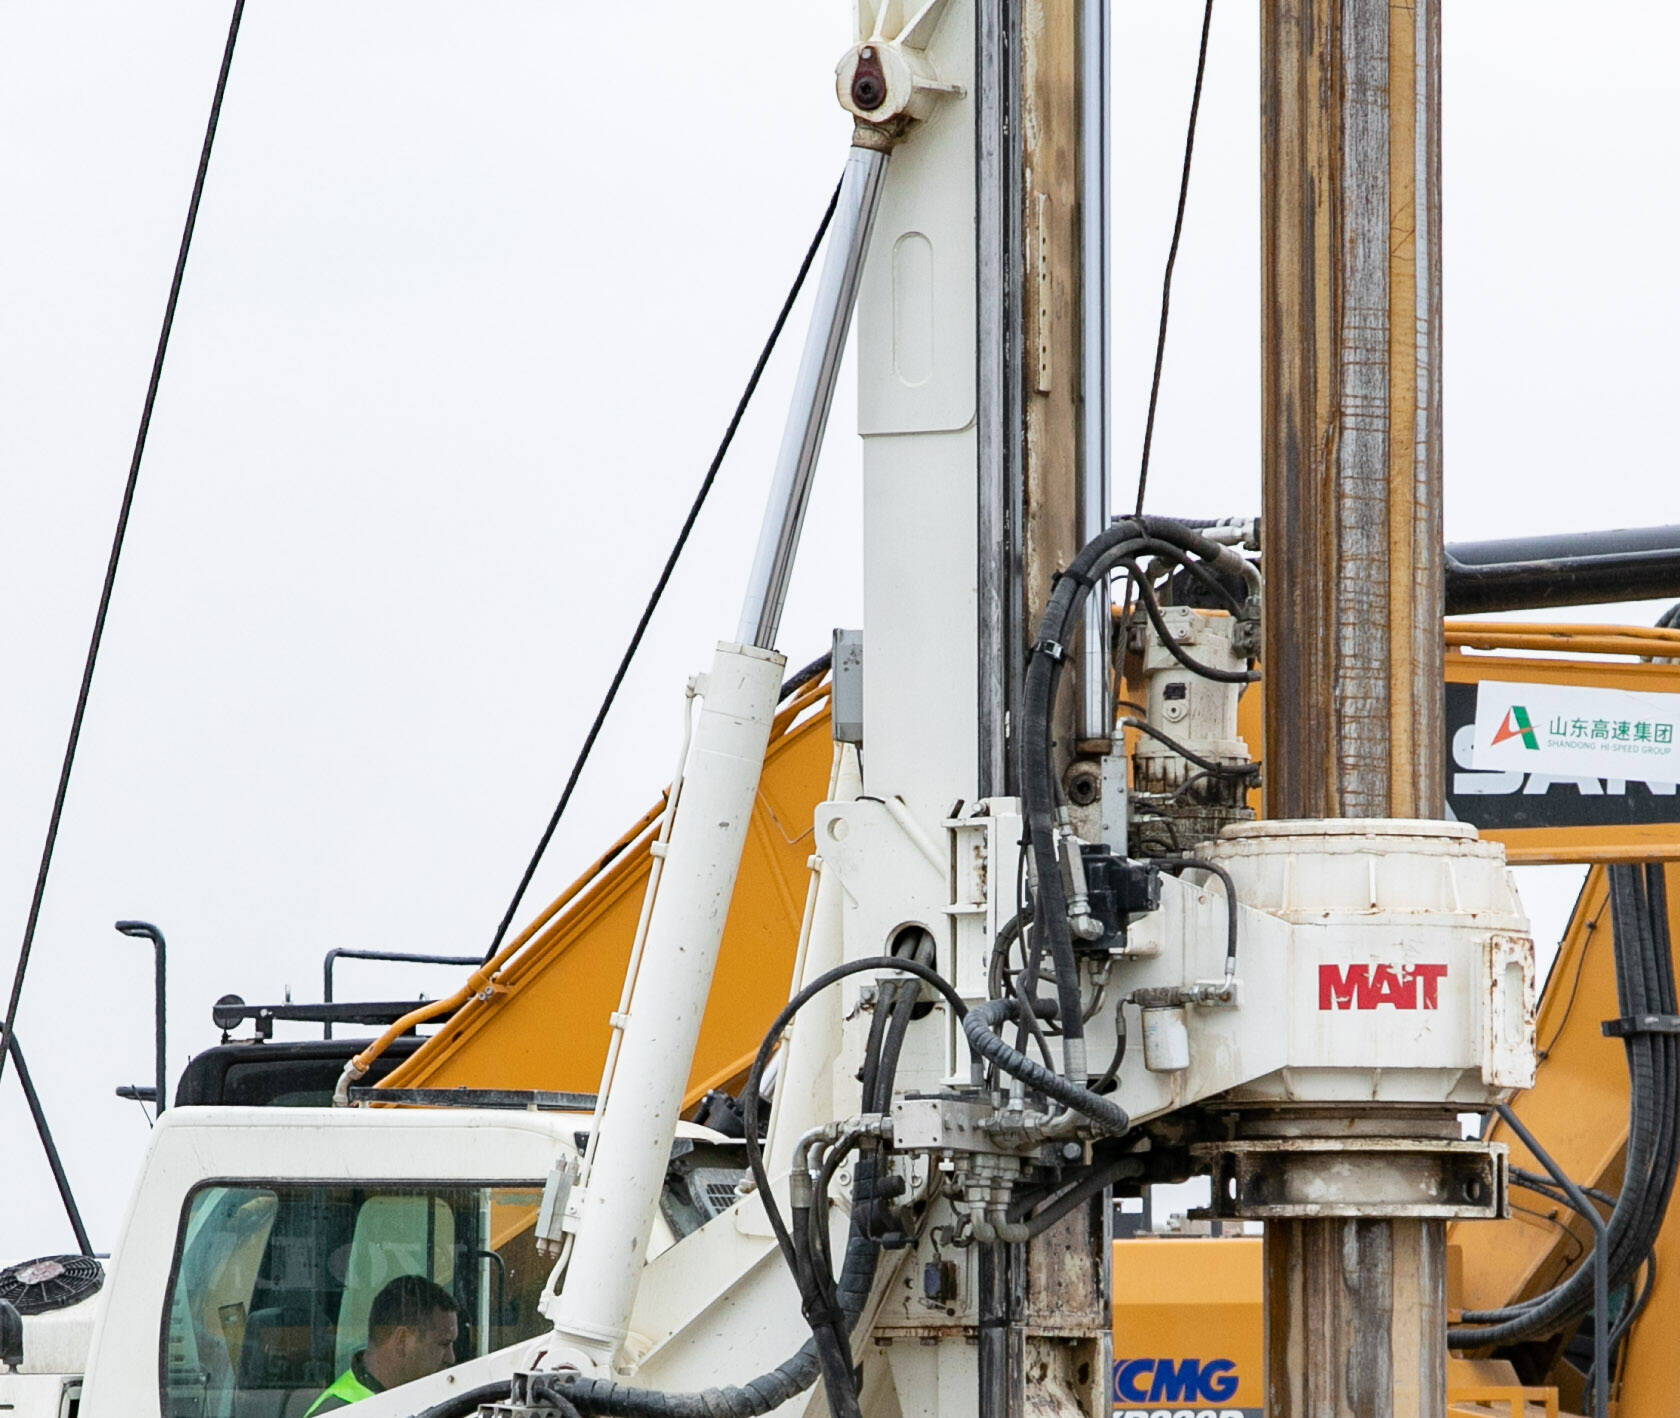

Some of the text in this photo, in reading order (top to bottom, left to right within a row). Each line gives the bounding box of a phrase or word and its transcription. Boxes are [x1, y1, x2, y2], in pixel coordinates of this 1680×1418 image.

[1549, 716, 1673, 744] 山东高速集团
[1547, 739, 1596, 751] SHANDONG
[1641, 745, 1672, 756] GROUP
